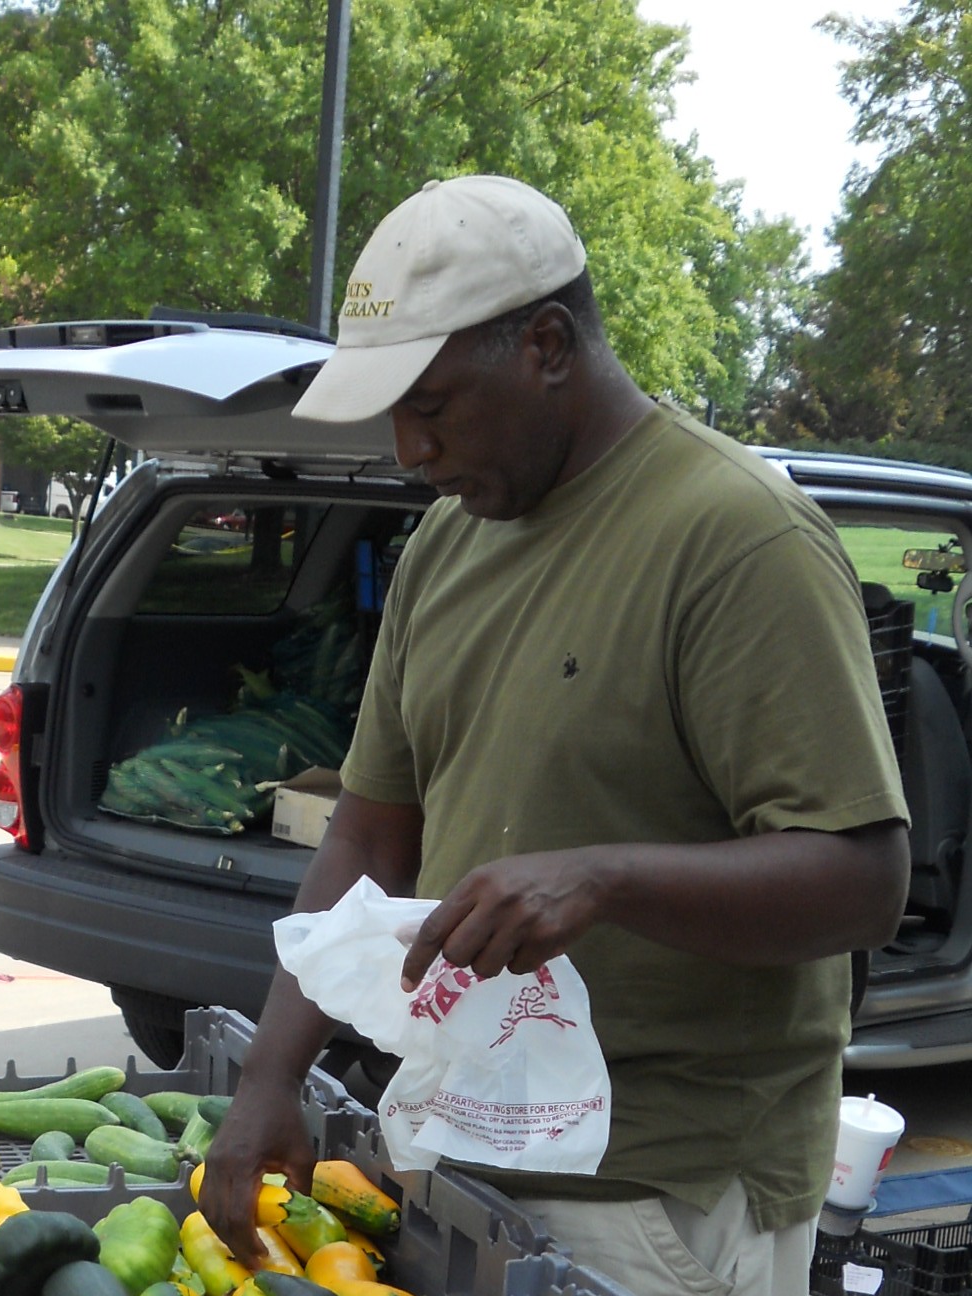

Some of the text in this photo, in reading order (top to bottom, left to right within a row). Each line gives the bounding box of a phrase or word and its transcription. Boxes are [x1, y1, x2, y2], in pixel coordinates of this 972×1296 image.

[344, 301, 394, 317] GRANT
[450, 1096, 505, 1114] PARTICIPATING
[505, 1105, 529, 1115] STORE
[530, 1105, 546, 1114] FOR
